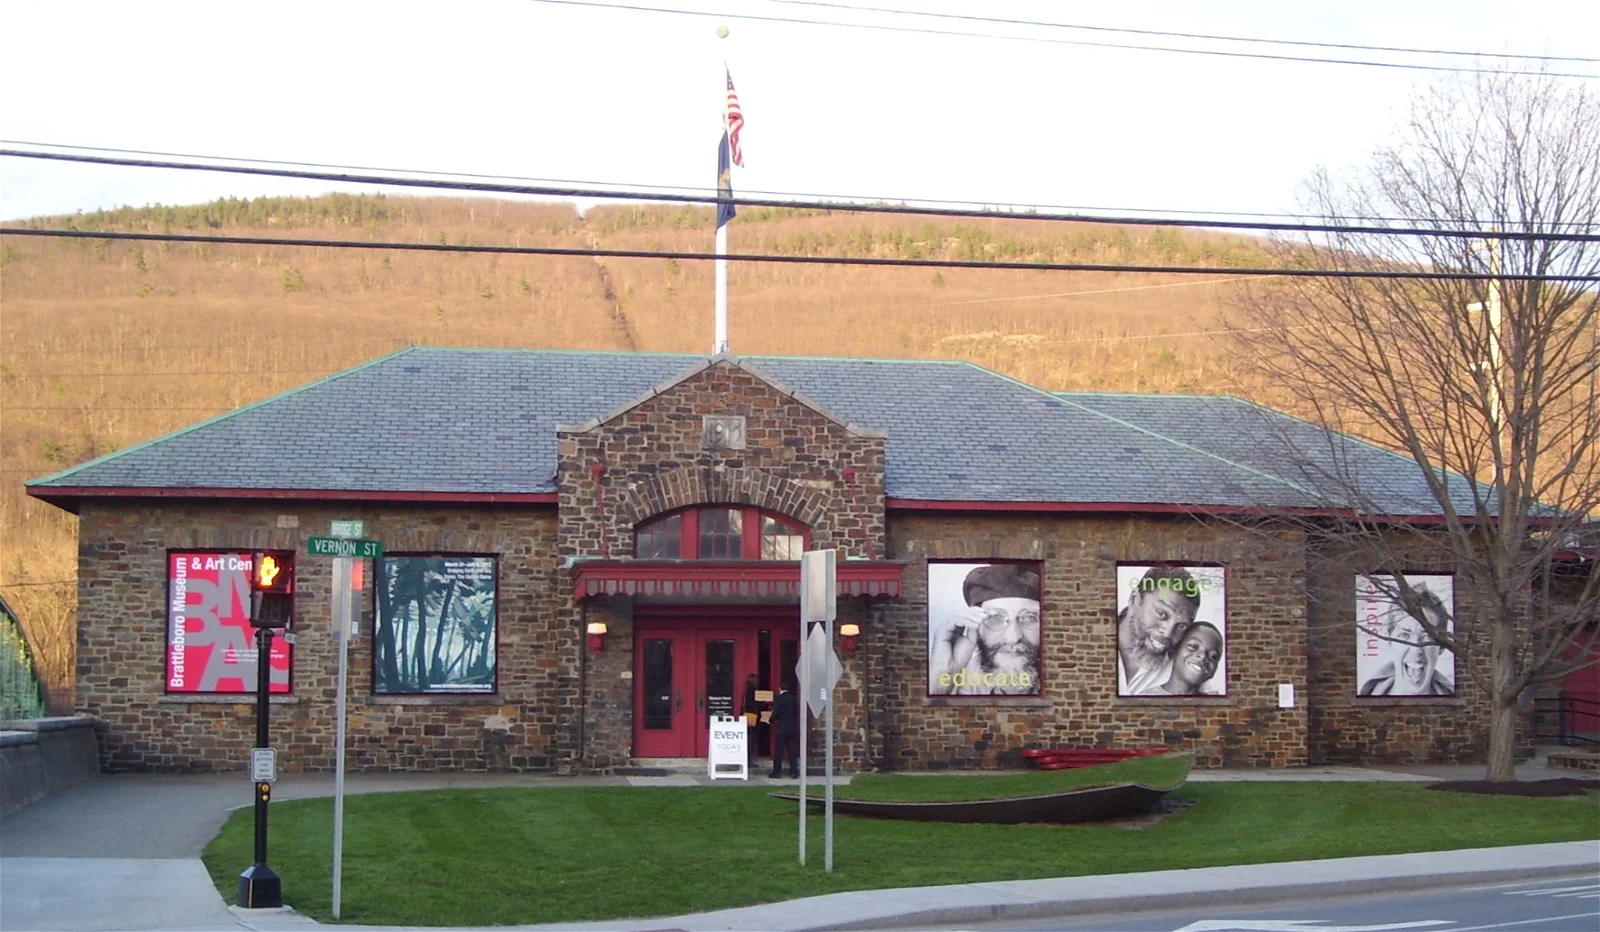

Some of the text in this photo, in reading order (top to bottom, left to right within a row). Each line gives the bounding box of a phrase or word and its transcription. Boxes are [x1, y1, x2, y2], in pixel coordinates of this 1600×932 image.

[314, 539, 378, 556] VERNON ST
[191, 557, 253, 571] & Art Cen
[1129, 577, 1212, 597] engage
[170, 557, 187, 688] Brattleboro Museum
[1363, 585, 1382, 657] inspire
[939, 667, 1031, 687] educate
[714, 731, 745, 740] EVENT
[716, 743, 741, 751] TODAY
